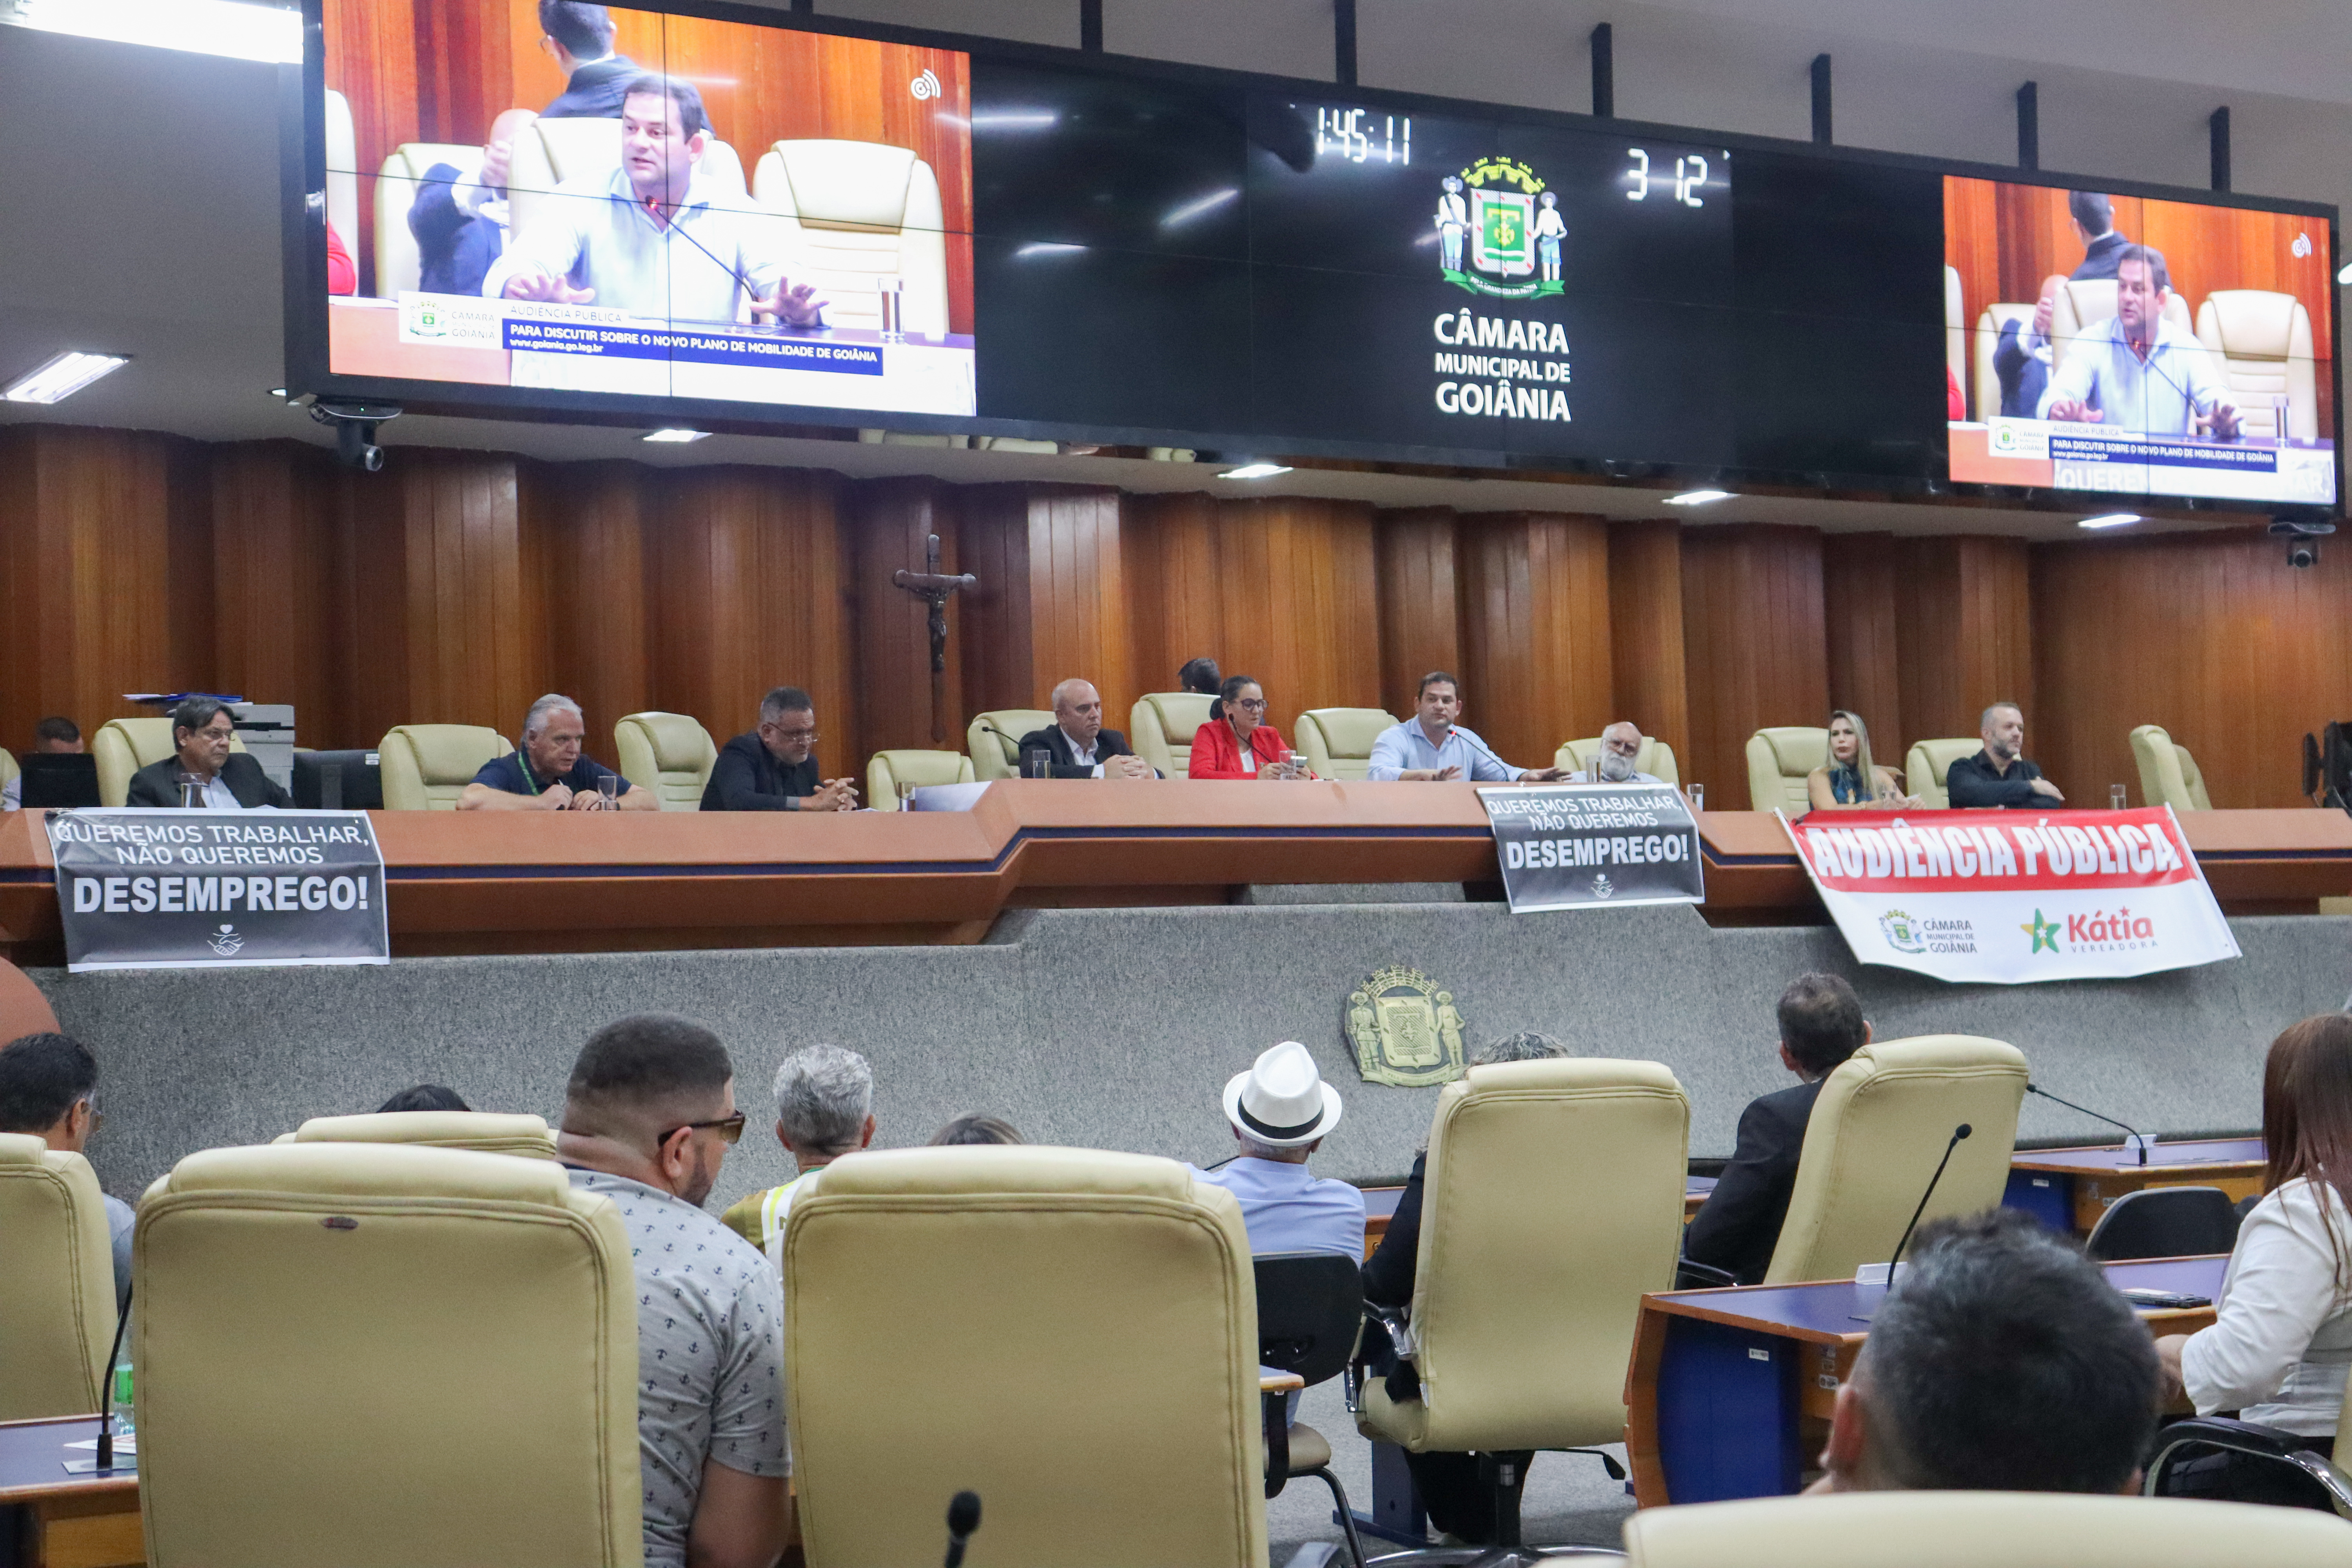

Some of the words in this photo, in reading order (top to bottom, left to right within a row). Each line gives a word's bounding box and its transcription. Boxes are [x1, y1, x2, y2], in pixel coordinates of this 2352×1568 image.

[1318, 107, 1410, 165] 1:45:11
[510, 305, 571, 318] AUDIÊNCIA
[510, 324, 542, 336] PARA
[544, 327, 598, 341] DISCUTIR
[600, 331, 639, 344] SOBRE
[641, 334, 651, 345] O
[653, 336, 688, 347] NOVO
[691, 338, 728, 350] PLANO
[731, 341, 746, 352] DE
[748, 342, 814, 357] MOBILIDADE
[817, 348, 831, 358] DE
[833, 348, 878, 361] GOIÂNIA
[1434, 307, 1570, 354] CÂMARA
[510, 339, 604, 353] www.goiania.go.leg.br
[1435, 352, 1543, 380] MUNICIPAL
[1545, 361, 1571, 383] DE
[1436, 379, 1572, 422] GOIÂNIA
[2054, 425, 2089, 434] AUDIÊNCIA
[2092, 427, 2119, 436] PÚBLICA
[2053, 439, 2072, 448] PARA
[2073, 441, 2105, 450] DISCUTIR
[2106, 443, 2129, 453] SOBRE
[2131, 445, 2136, 454] O
[2138, 446, 2159, 455] NOVO
[2160, 448, 2183, 457] PLANO
[2185, 449, 2193, 457] DE
[2195, 450, 2235, 461] MOBILIDADE
[2236, 452, 2245, 461] DE
[2247, 452, 2274, 463] GOIÂNIA
[1487, 798, 1579, 815] QUEREMOS
[1579, 795, 1682, 812] TRABALHAR,
[1529, 812, 1565, 831] NÃO
[1570, 812, 1658, 829] QUEREMOS
[55, 825, 203, 843] QUEREMOS
[207, 826, 368, 846] TRABALHAR,
[116, 841, 172, 865] NÃO
[182, 847, 323, 865] QUEREMOS
[1506, 834, 1689, 869] DESEMPREGO!
[1806, 818, 2018, 878] AUDIÊNCIA
[2011, 818, 2183, 875] PÚBLICA
[74, 876, 368, 913] DESEMPREGO!
[1924, 918, 1972, 930] CÂMARA
[2069, 906, 2154, 942] Kátia
[1930, 940, 1978, 953] GOIÂNIA
[2071, 940, 2158, 953] VEREADORA
